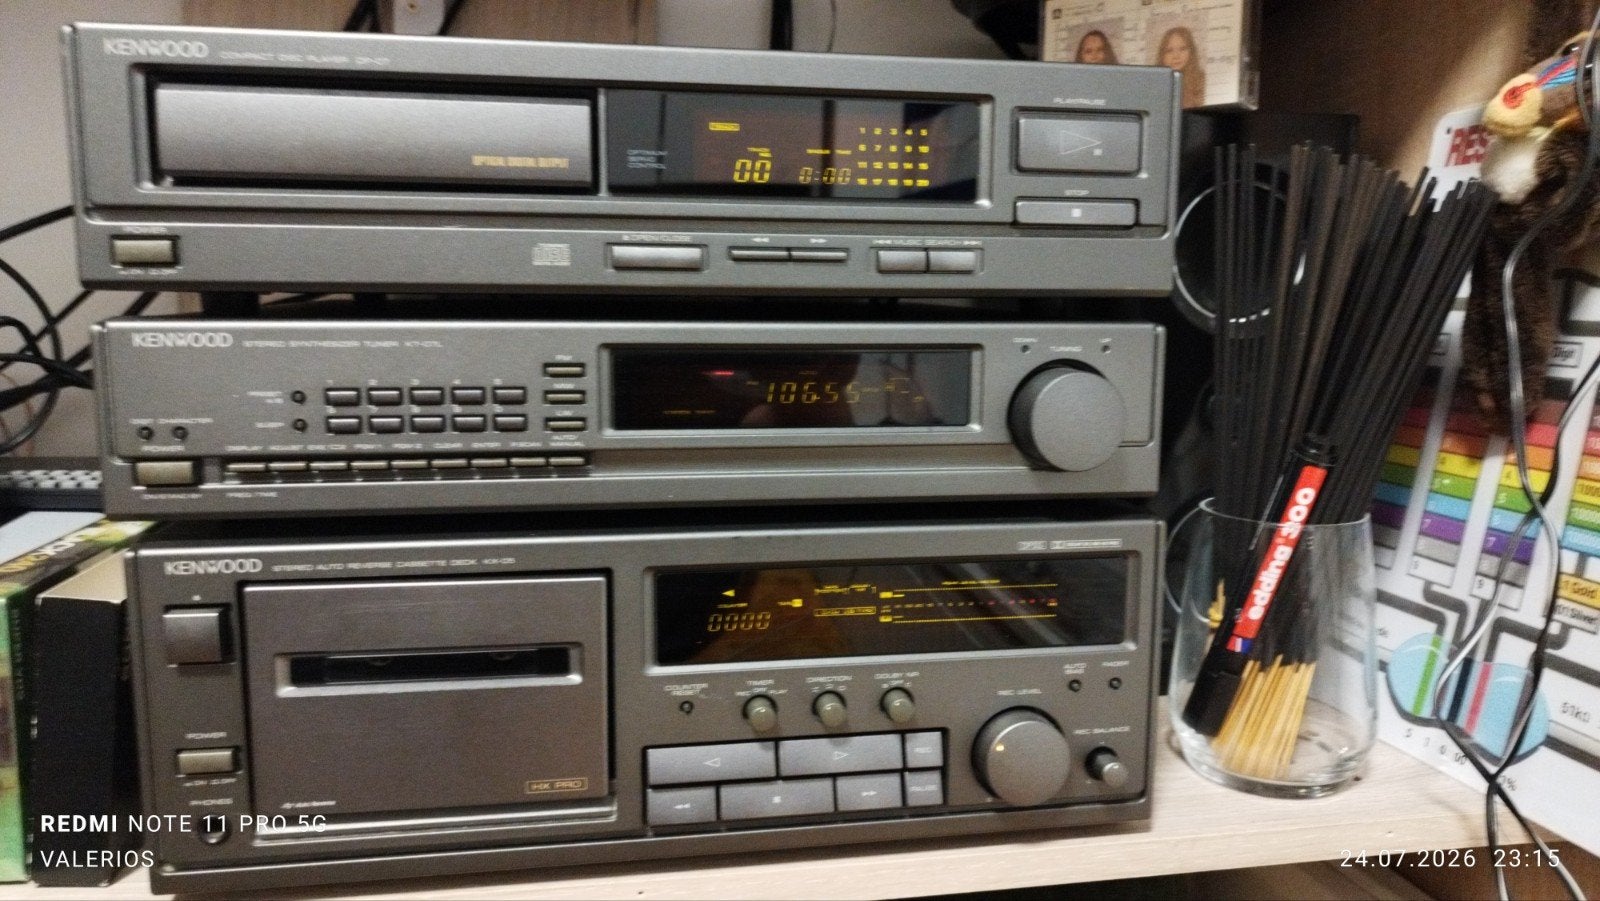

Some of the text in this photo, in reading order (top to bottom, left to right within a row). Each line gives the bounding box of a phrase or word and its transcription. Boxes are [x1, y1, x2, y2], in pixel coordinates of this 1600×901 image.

[103, 38, 209, 57] KENWOOD
[733, 159, 771, 183] 00
[799, 167, 852, 184] 0:00
[131, 332, 234, 348] KENWOOD
[1248, 486, 1317, 621] edding 300
[163, 558, 263, 575] KENWOOD
[272, 564, 314, 573] STEREO
[316, 563, 345, 571] AUTO
[347, 562, 394, 571] REVERSE
[395, 560, 448, 569] CASSETTE
[449, 559, 478, 568] DECK
[706, 611, 772, 632] 0000
[746, 679, 775, 687] TIMER
[805, 675, 853, 684] DIRECTION
[186, 731, 227, 740] POWER
